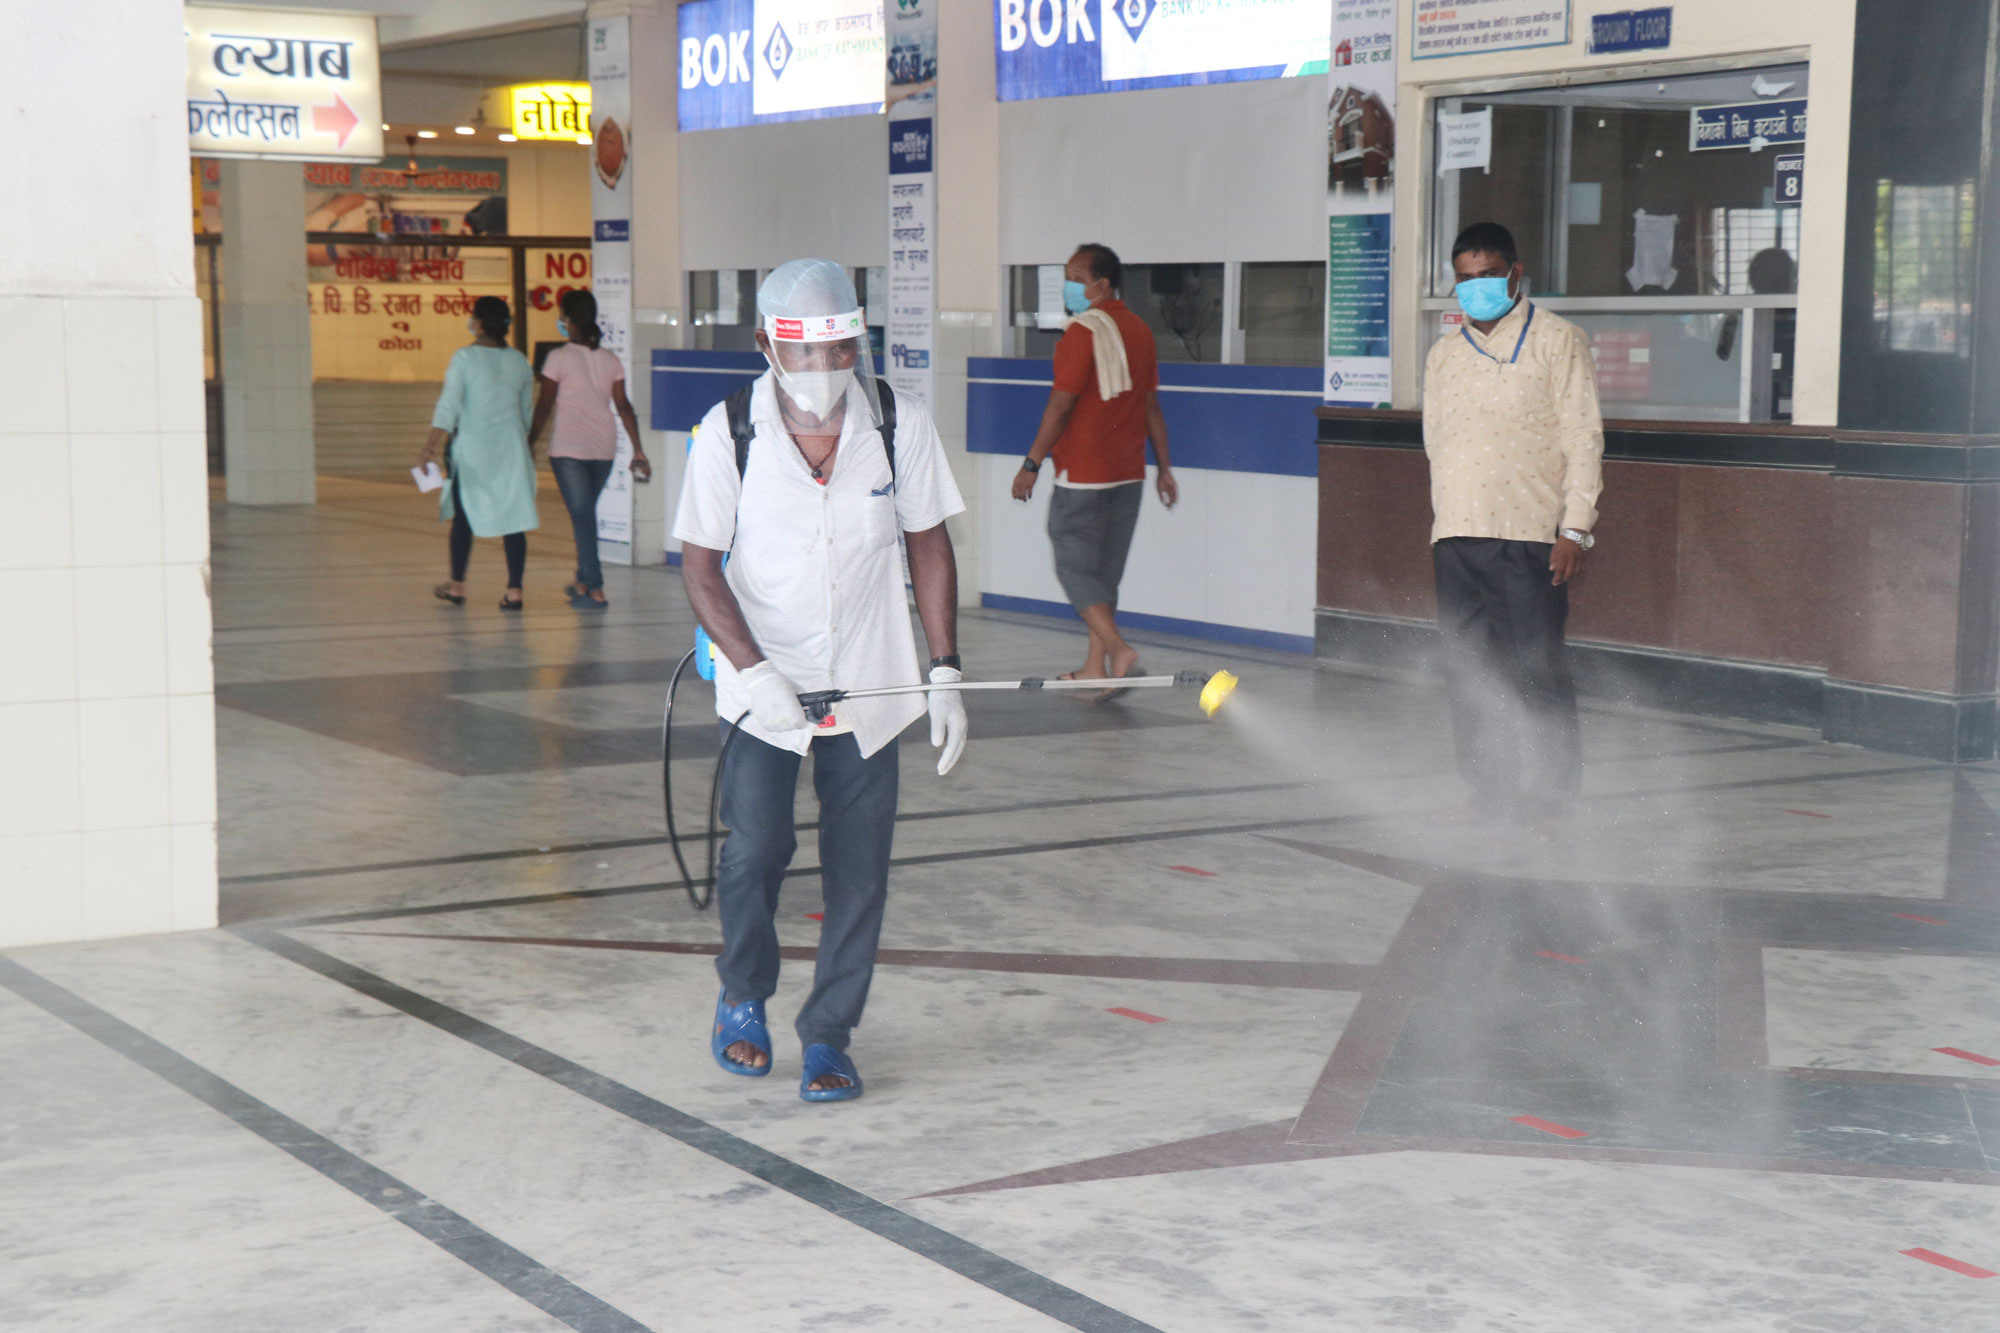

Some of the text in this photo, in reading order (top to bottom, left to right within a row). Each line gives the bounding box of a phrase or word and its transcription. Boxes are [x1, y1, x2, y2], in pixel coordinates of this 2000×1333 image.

[1161, 0, 1194, 18] BANK
[1001, 0, 1096, 52] BOK
[1592, 16, 1667, 45] GROUND FLOOR
[210, 34, 354, 80] ल्याब
[681, 30, 752, 90] BOK
[835, 36, 885, 57] KATHMAND
[521, 92, 592, 132] नोबे
[1785, 177, 1798, 197] 8
[546, 252, 592, 279] NO
